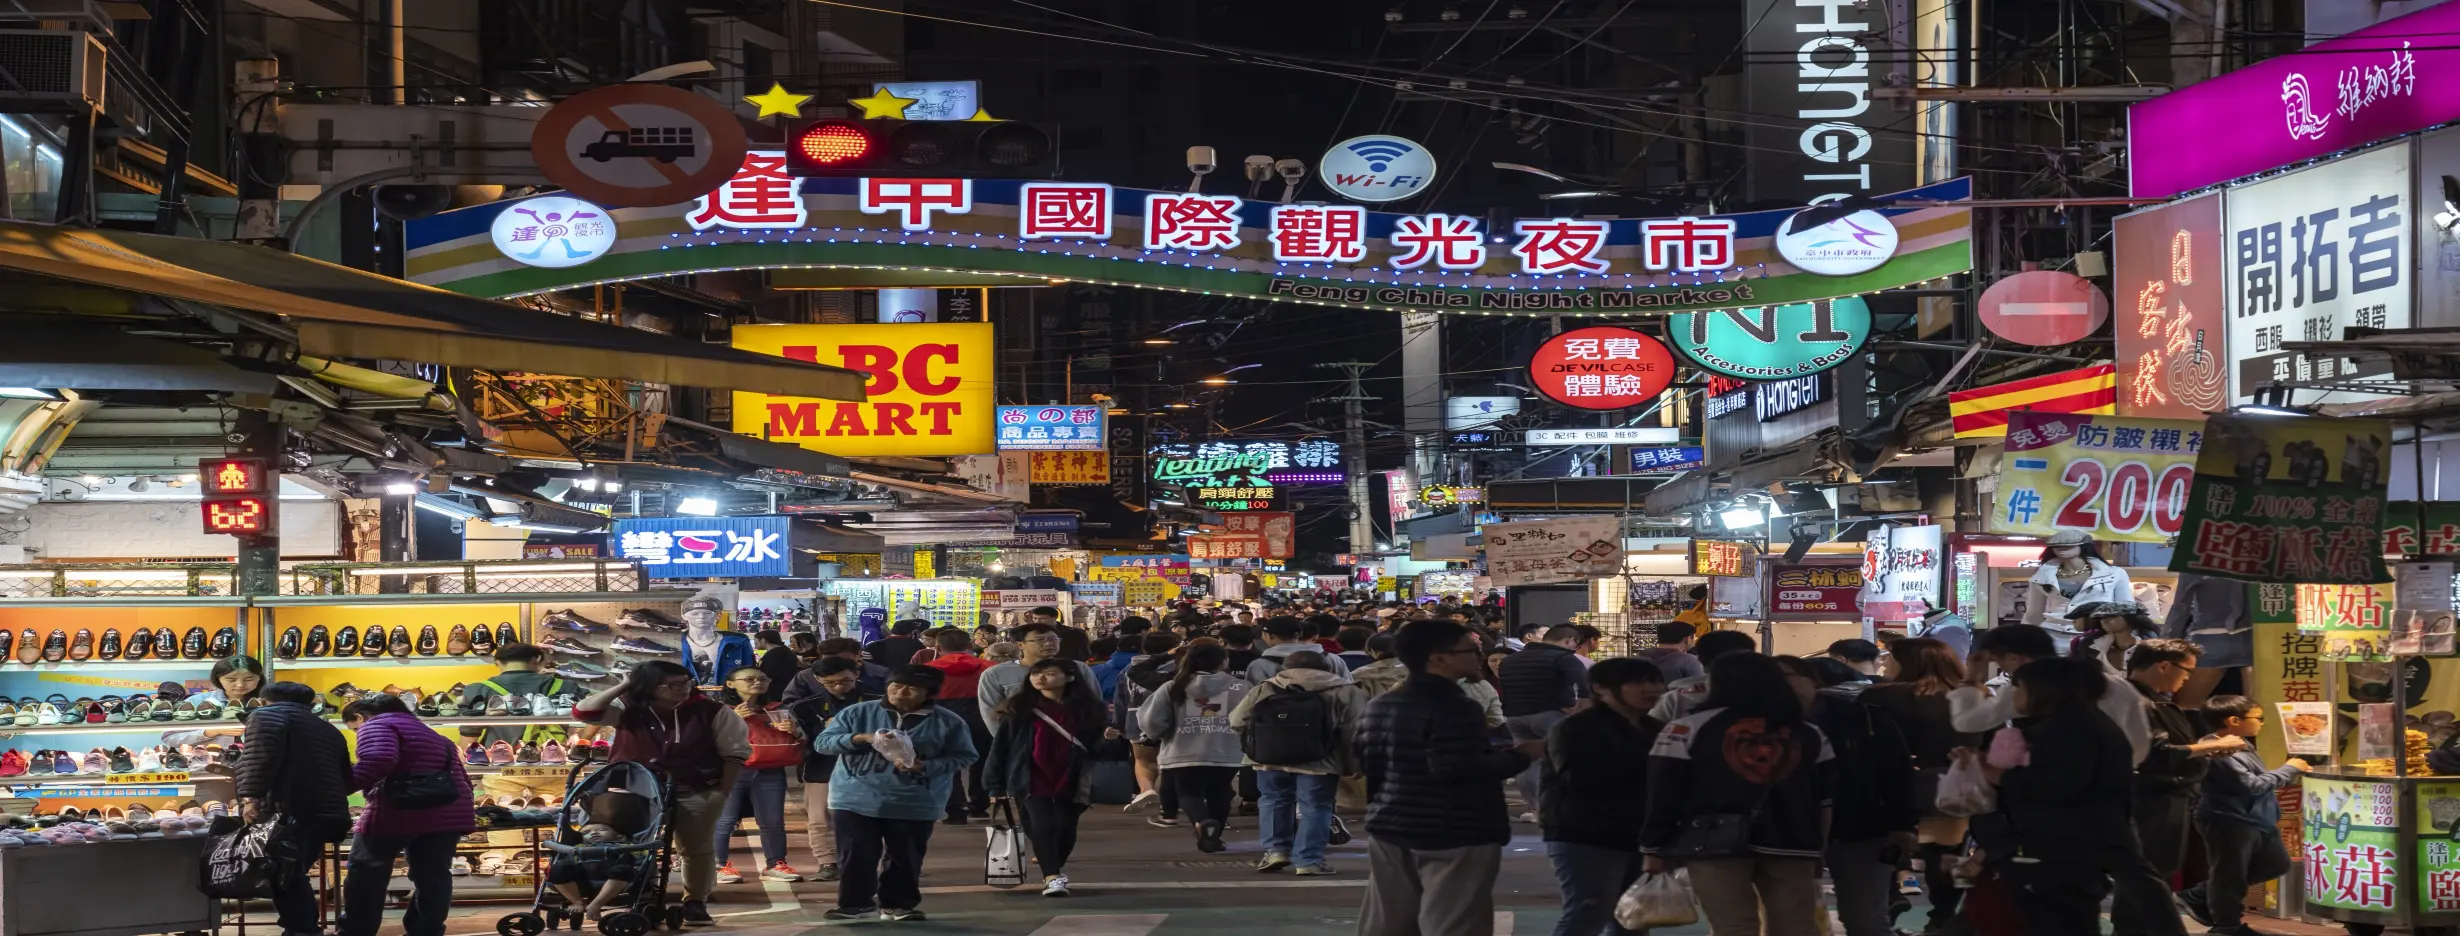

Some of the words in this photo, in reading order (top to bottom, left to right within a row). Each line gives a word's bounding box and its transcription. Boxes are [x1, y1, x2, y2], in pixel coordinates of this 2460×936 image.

[2336, 41, 2416, 121] 維納詩
[1336, 173, 1422, 188] Wi-Fi
[688, 143, 1735, 274] 逢甲國際觀光夜市
[2237, 194, 2401, 318] 開拓者
[1268, 278, 1370, 304] Feng
[1376, 287, 1467, 308] Chia
[1480, 290, 1595, 311] Night
[1600, 283, 1754, 308] Market
[2255, 324, 2283, 352] 西服
[1564, 338, 1641, 360] 免費
[1691, 345, 1793, 376] Accessories
[1798, 362, 1813, 372] &
[1812, 343, 1853, 368] Bags
[1551, 363, 1655, 372] DEVILCASE
[1564, 374, 1642, 397] 體驗
[766, 402, 962, 436] MART
[1002, 407, 1096, 424] 尚の都
[1002, 426, 1099, 439] 商品專賣
[1535, 432, 1548, 440] 3C
[1554, 432, 1578, 440] 配件
[1585, 431, 1609, 440] 包膜
[1614, 431, 1639, 439] 維修
[2010, 420, 2071, 448] 免燙
[1032, 451, 1107, 472] 紫雲神算
[1634, 447, 1686, 468] 男裝
[1675, 462, 1696, 470] SIZE
[2008, 459, 2048, 525] 一件
[2052, 457, 2195, 537] 200
[210, 500, 260, 528] 62
[2244, 493, 2317, 519] 100%
[2322, 495, 2380, 525] 全素
[1226, 516, 1261, 531] 按摩
[566, 547, 594, 556] SALE
[1192, 541, 1260, 557] 肩頸舒壓
[1779, 602, 1838, 610] 每份60元
[1177, 726, 1198, 734] NOT
[2373, 784, 2391, 794] 100
[2373, 795, 2392, 804] 100
[2373, 805, 2392, 815] 200
[2375, 816, 2393, 826] 50
[2427, 842, 2448, 868] 逢甲
